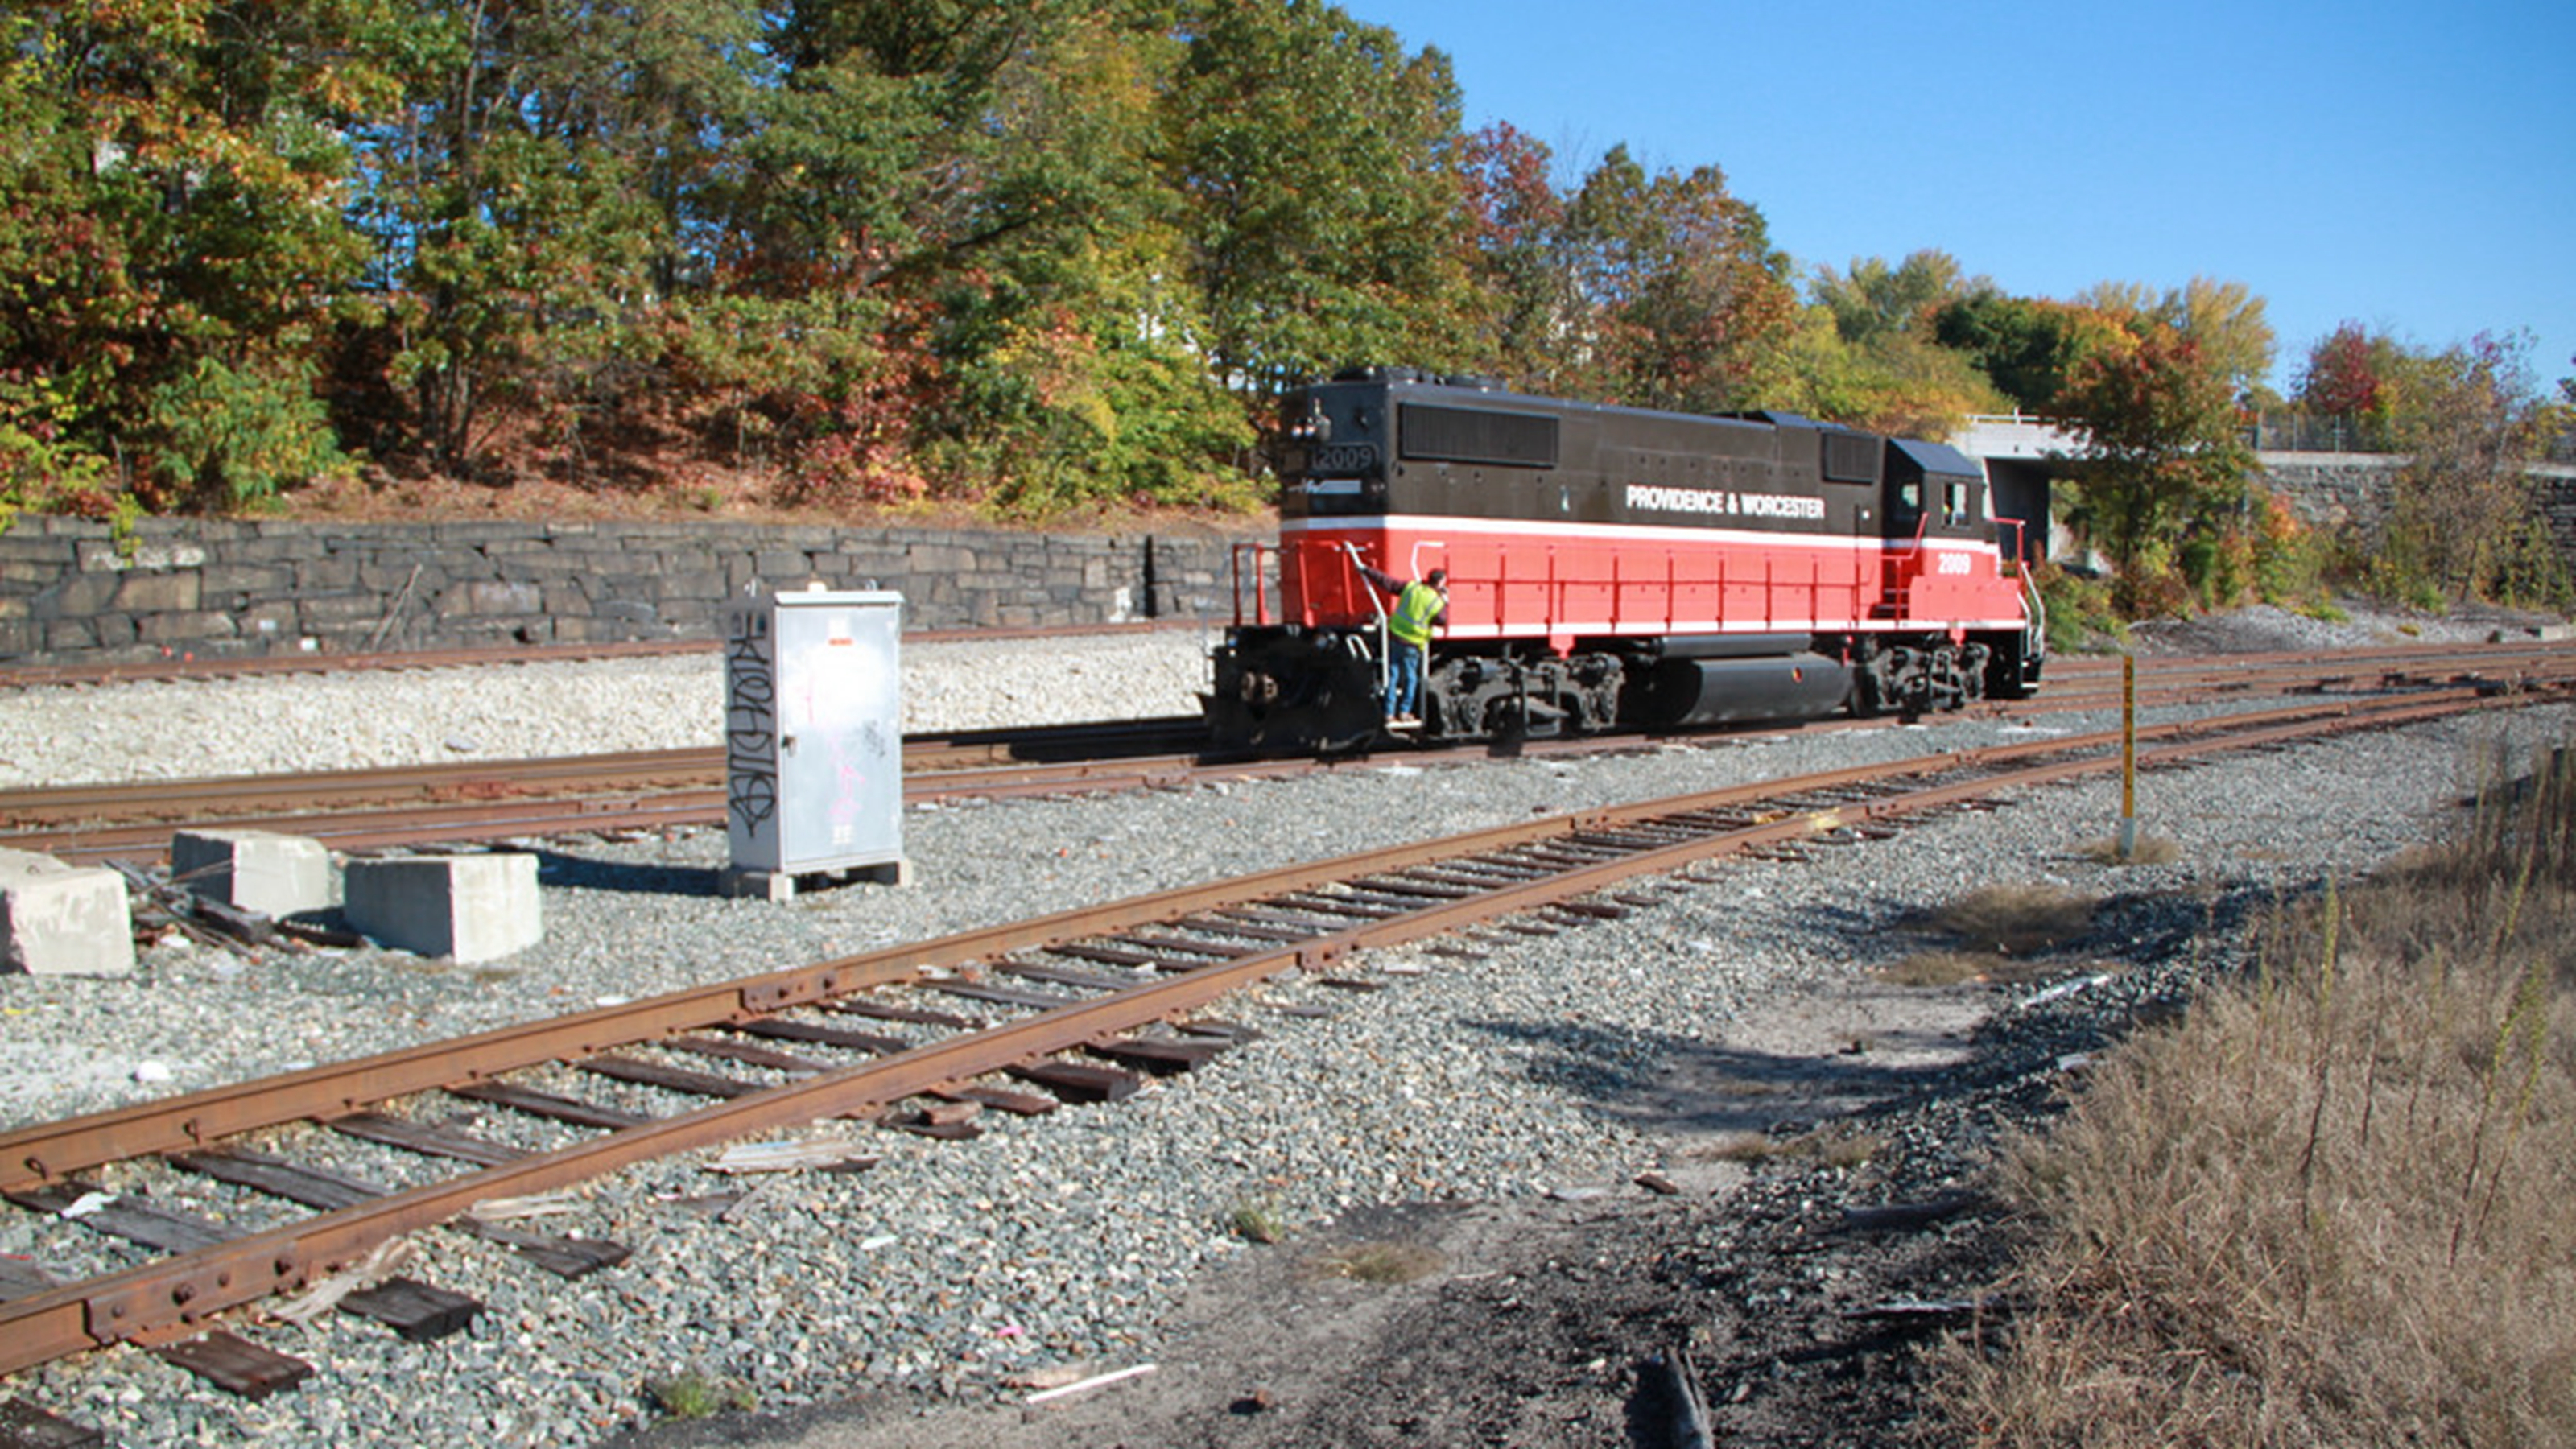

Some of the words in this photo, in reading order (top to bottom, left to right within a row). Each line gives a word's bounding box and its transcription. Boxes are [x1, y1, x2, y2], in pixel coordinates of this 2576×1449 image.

[1319, 447, 1372, 469] 2009
[1626, 485, 1723, 514] PROVIDENCE
[1727, 492, 1738, 515] &
[1740, 493, 1826, 519] WORCESTER
[1938, 552, 1971, 575] 2009
